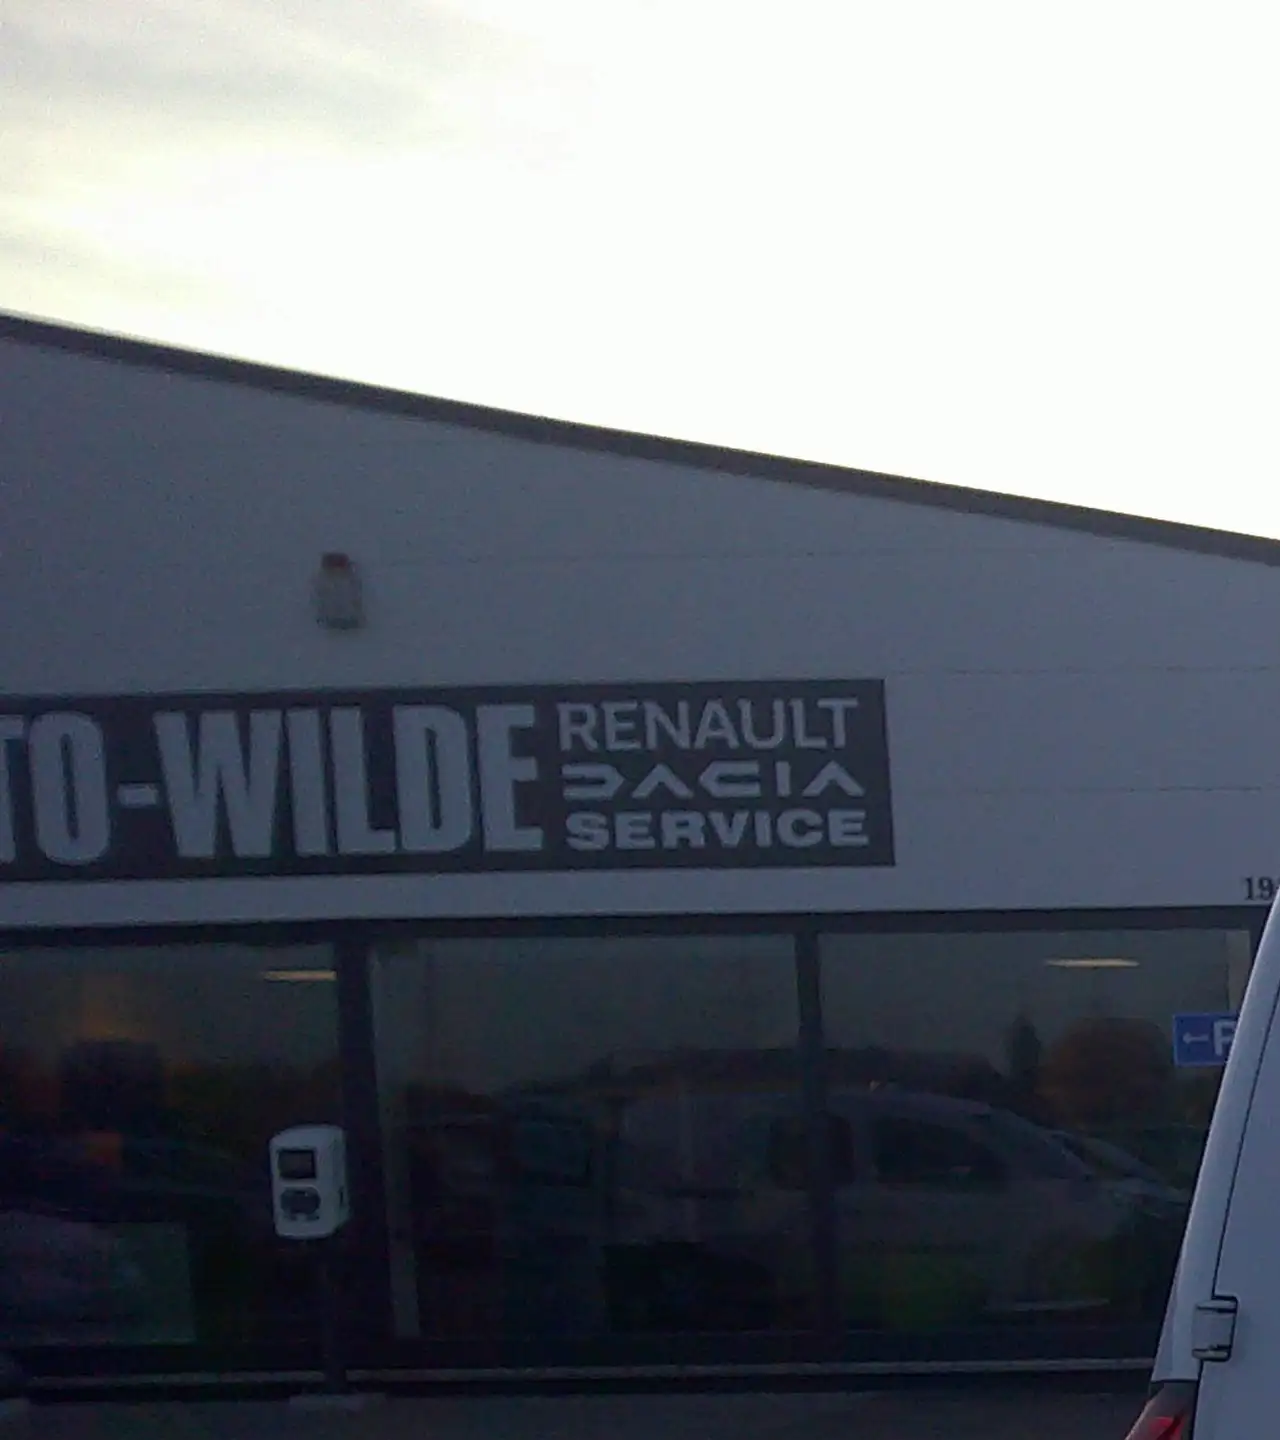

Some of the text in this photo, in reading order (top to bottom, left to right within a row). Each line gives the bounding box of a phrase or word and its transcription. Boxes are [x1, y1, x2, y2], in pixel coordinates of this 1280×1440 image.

[556, 698, 858, 750] RENAULT
[561, 760, 866, 800] DACIA
[565, 808, 870, 851] SERVICE
